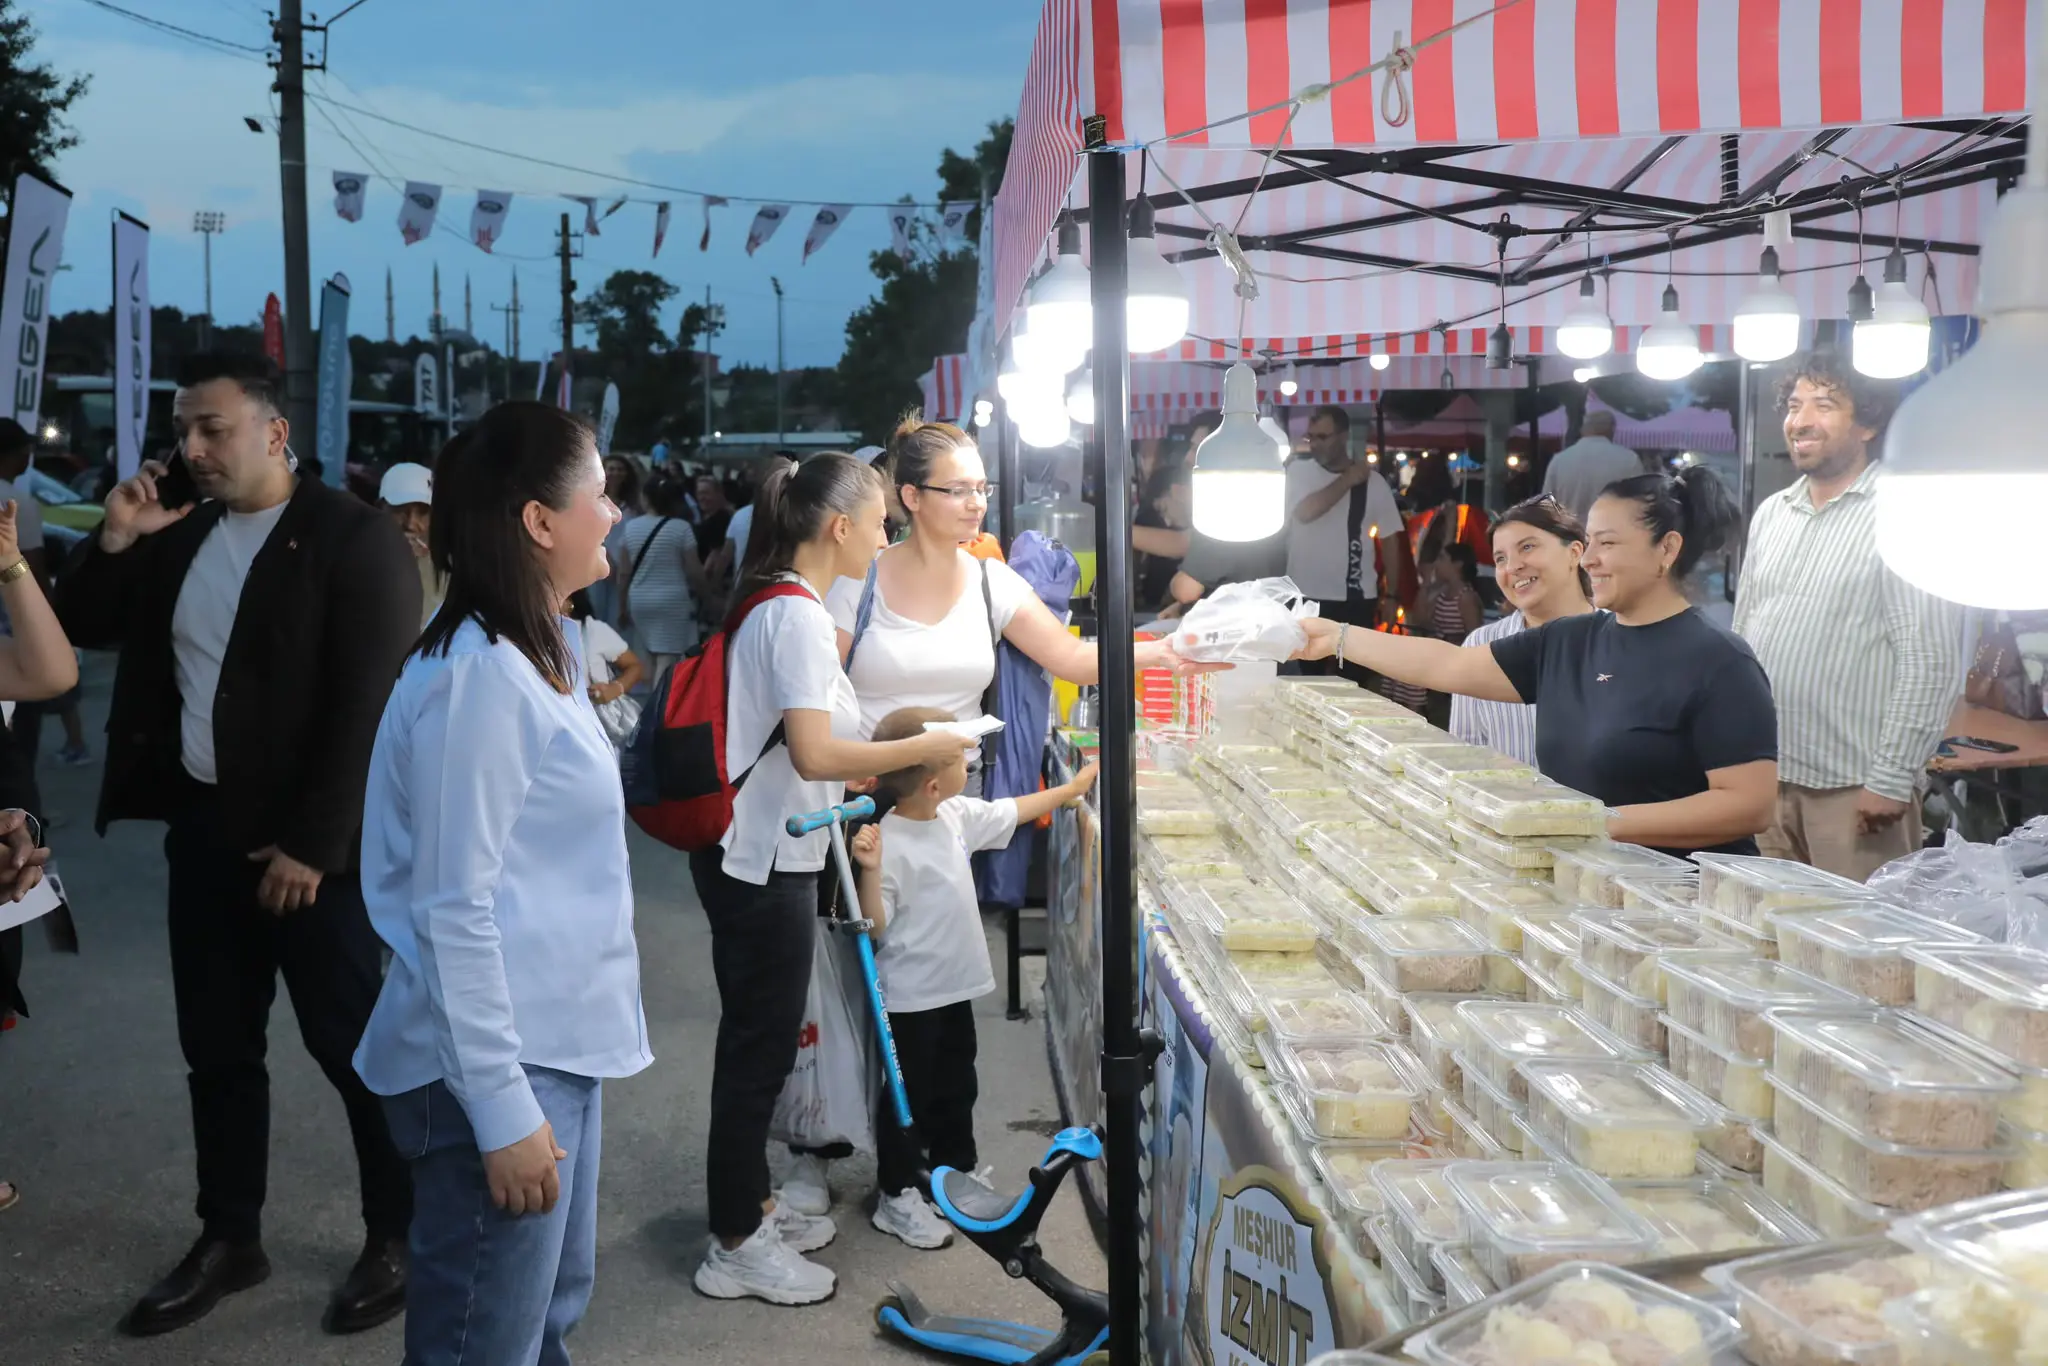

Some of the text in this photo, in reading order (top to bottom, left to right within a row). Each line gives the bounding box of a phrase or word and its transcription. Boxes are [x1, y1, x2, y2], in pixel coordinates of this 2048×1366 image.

[1349, 538, 1363, 590] GANT
[1233, 1205, 1298, 1274] MEŞHUR
[1220, 1249, 1314, 1366] İZMİT
